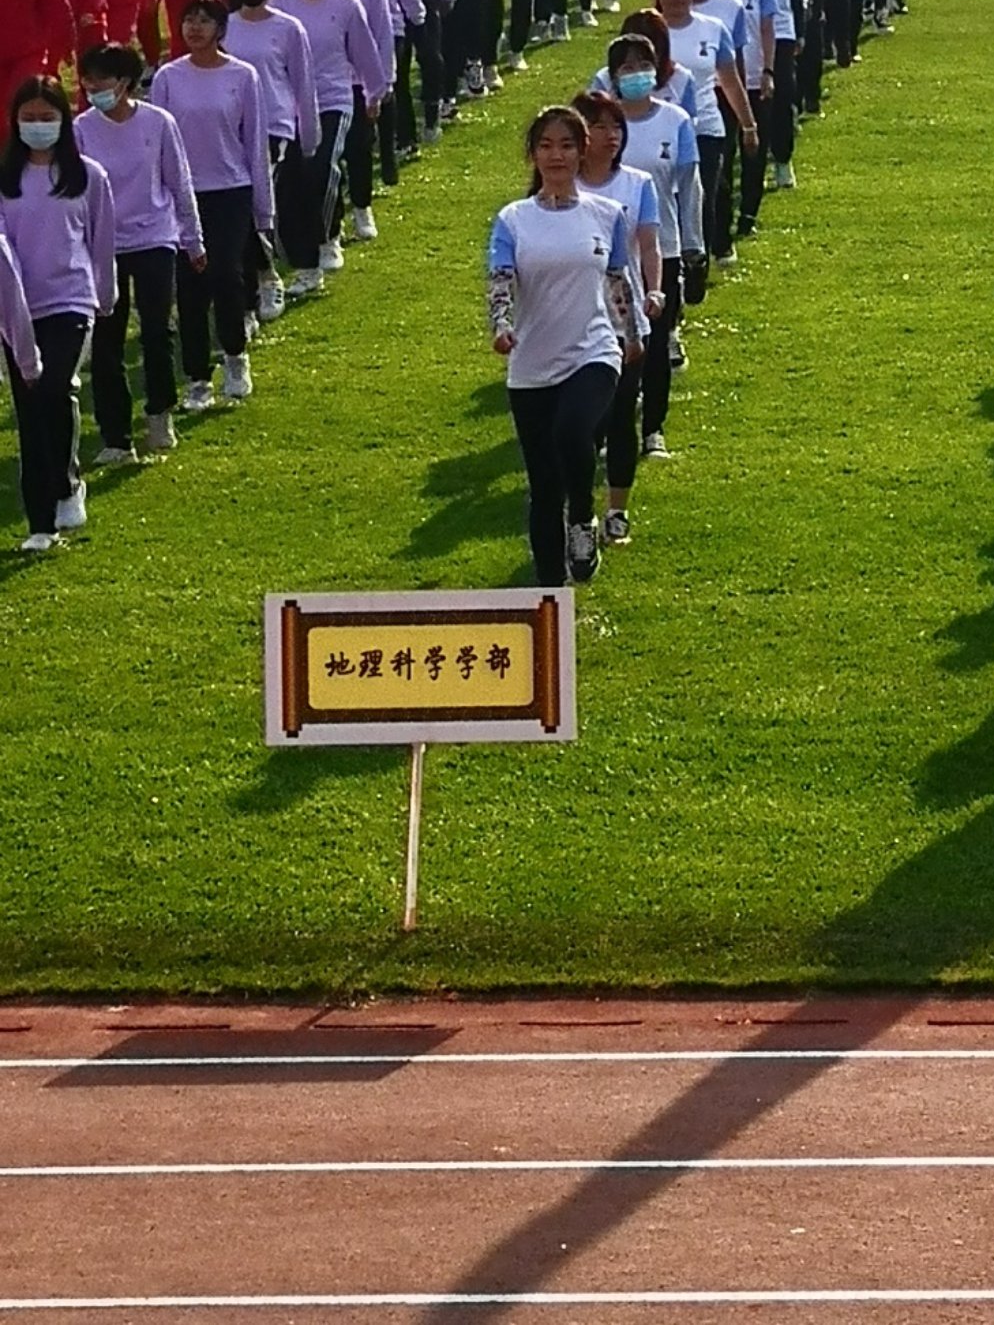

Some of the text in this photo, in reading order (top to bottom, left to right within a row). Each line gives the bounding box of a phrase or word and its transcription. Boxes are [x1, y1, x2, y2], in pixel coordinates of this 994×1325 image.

[323, 643, 511, 681] 地理科学学部
